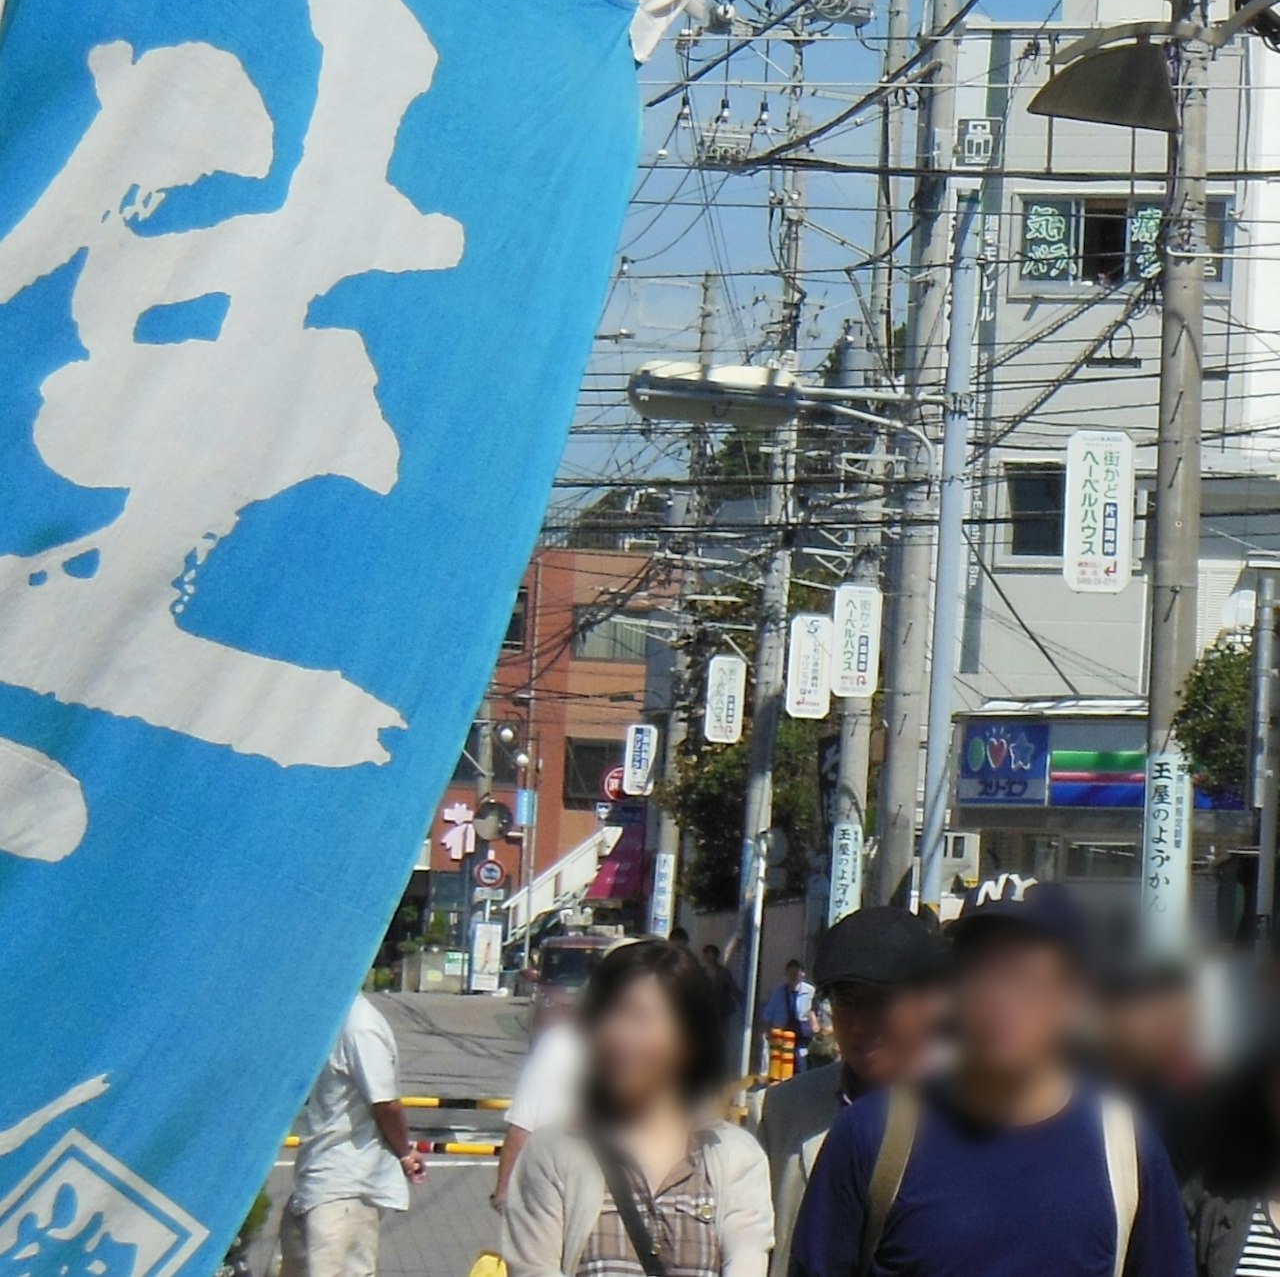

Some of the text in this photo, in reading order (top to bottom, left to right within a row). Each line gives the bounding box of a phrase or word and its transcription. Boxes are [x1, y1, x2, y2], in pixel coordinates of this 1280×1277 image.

[1081, 450, 1100, 556] ヘーベルハウス
[975, 872, 1039, 907] NY
